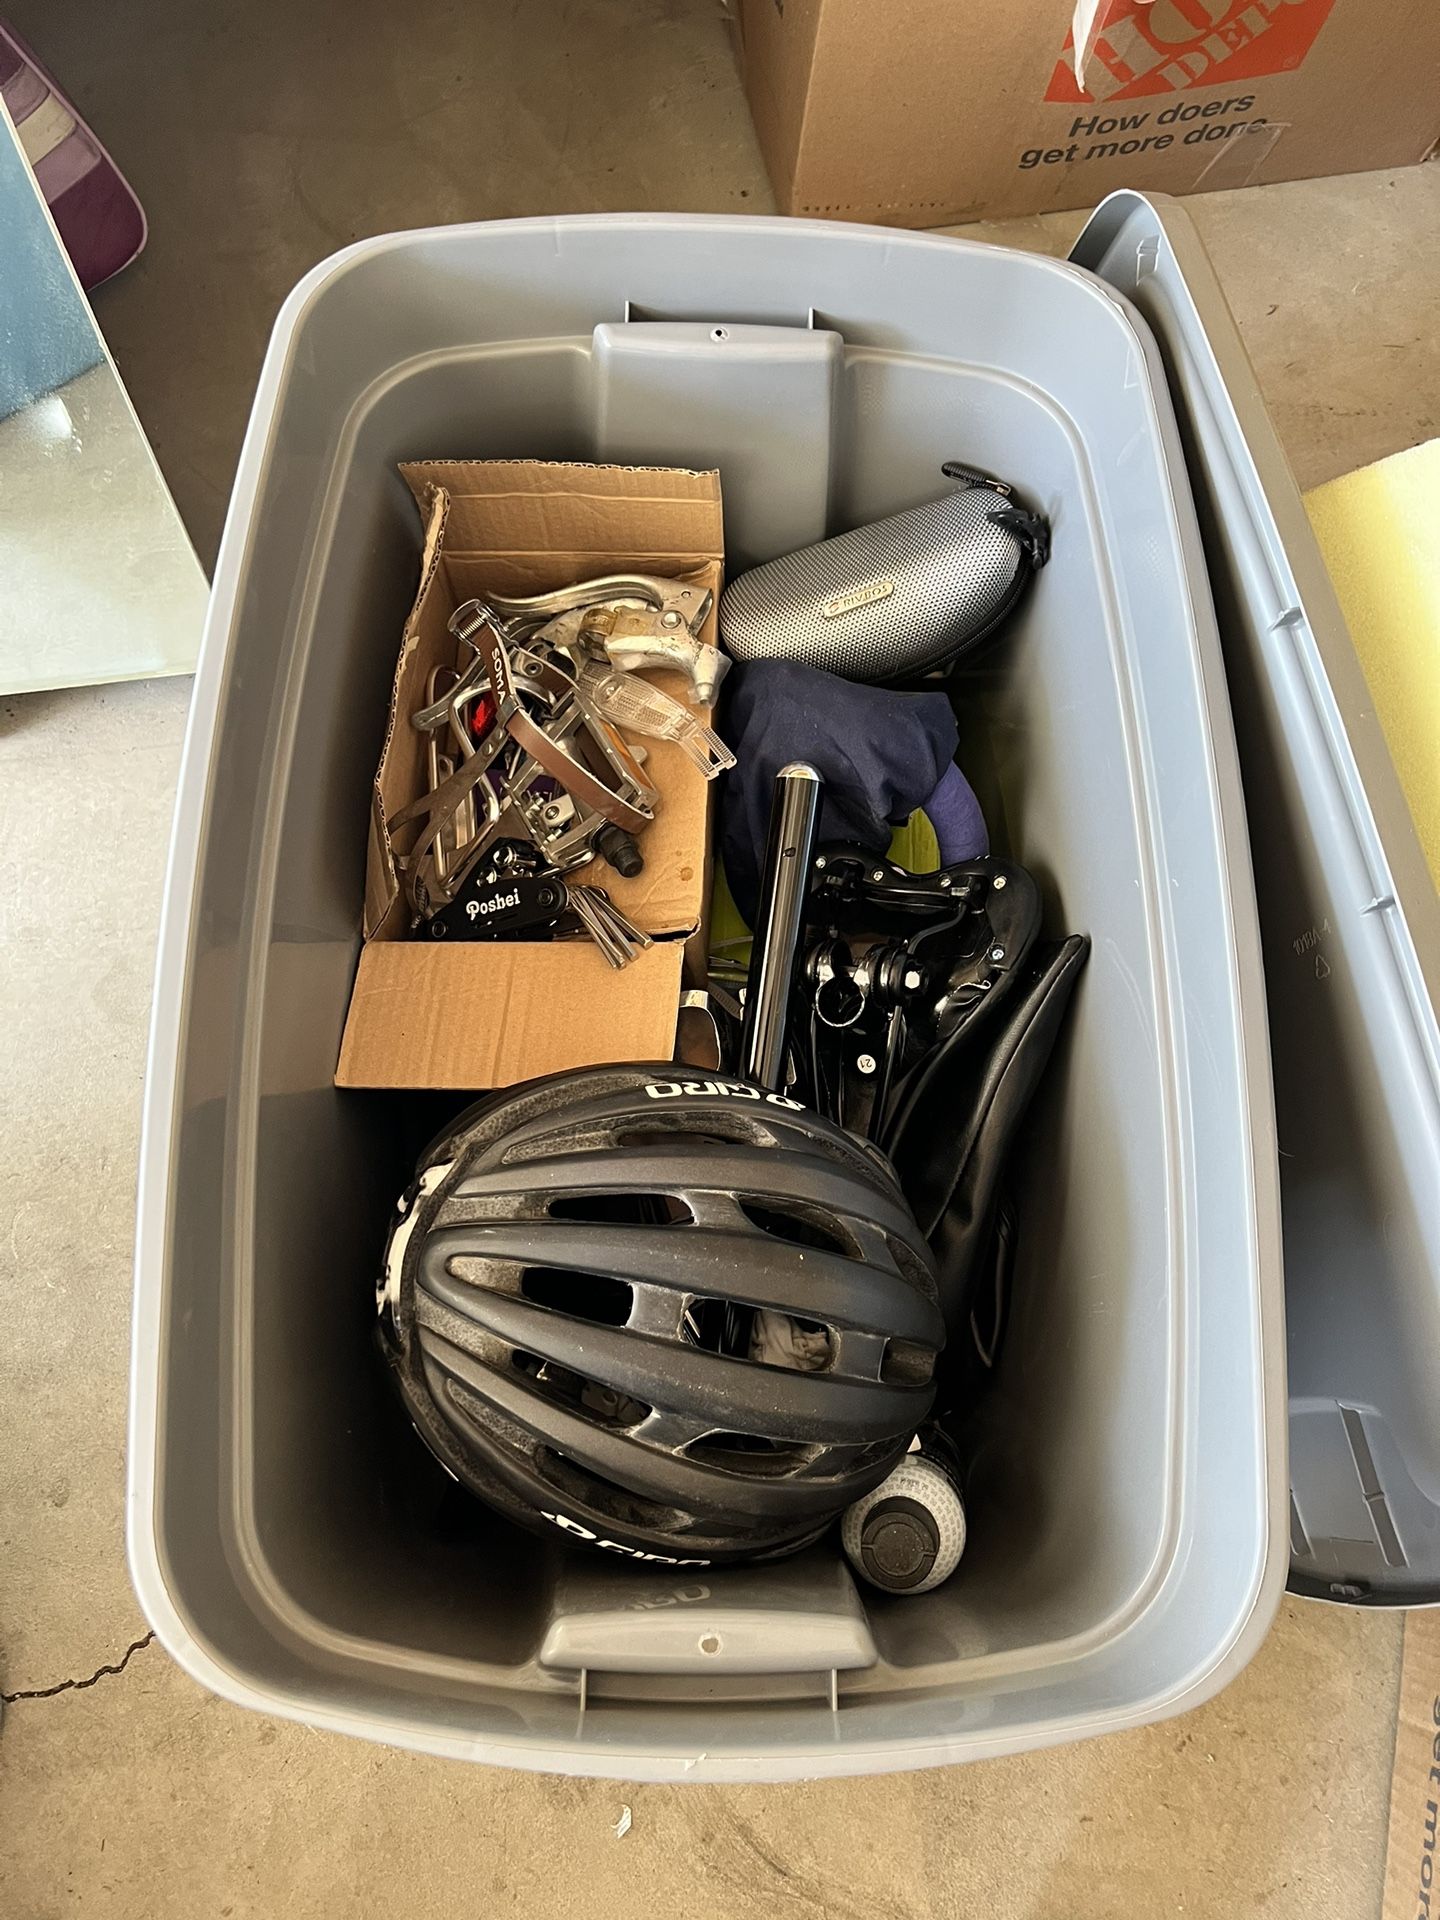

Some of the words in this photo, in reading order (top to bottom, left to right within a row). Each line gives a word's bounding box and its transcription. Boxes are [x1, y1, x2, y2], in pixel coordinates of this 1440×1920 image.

[1062, 0, 1233, 101] HO
[1068, 113, 1148, 138] How
[1157, 94, 1257, 126] doers
[1018, 143, 1080, 169] get
[1084, 133, 1175, 160] more
[841, 584, 889, 607] RIVBOS
[490, 647, 508, 706] SOMA
[860, 1058, 873, 1069] 21
[644, 1081, 760, 1100] GIRO
